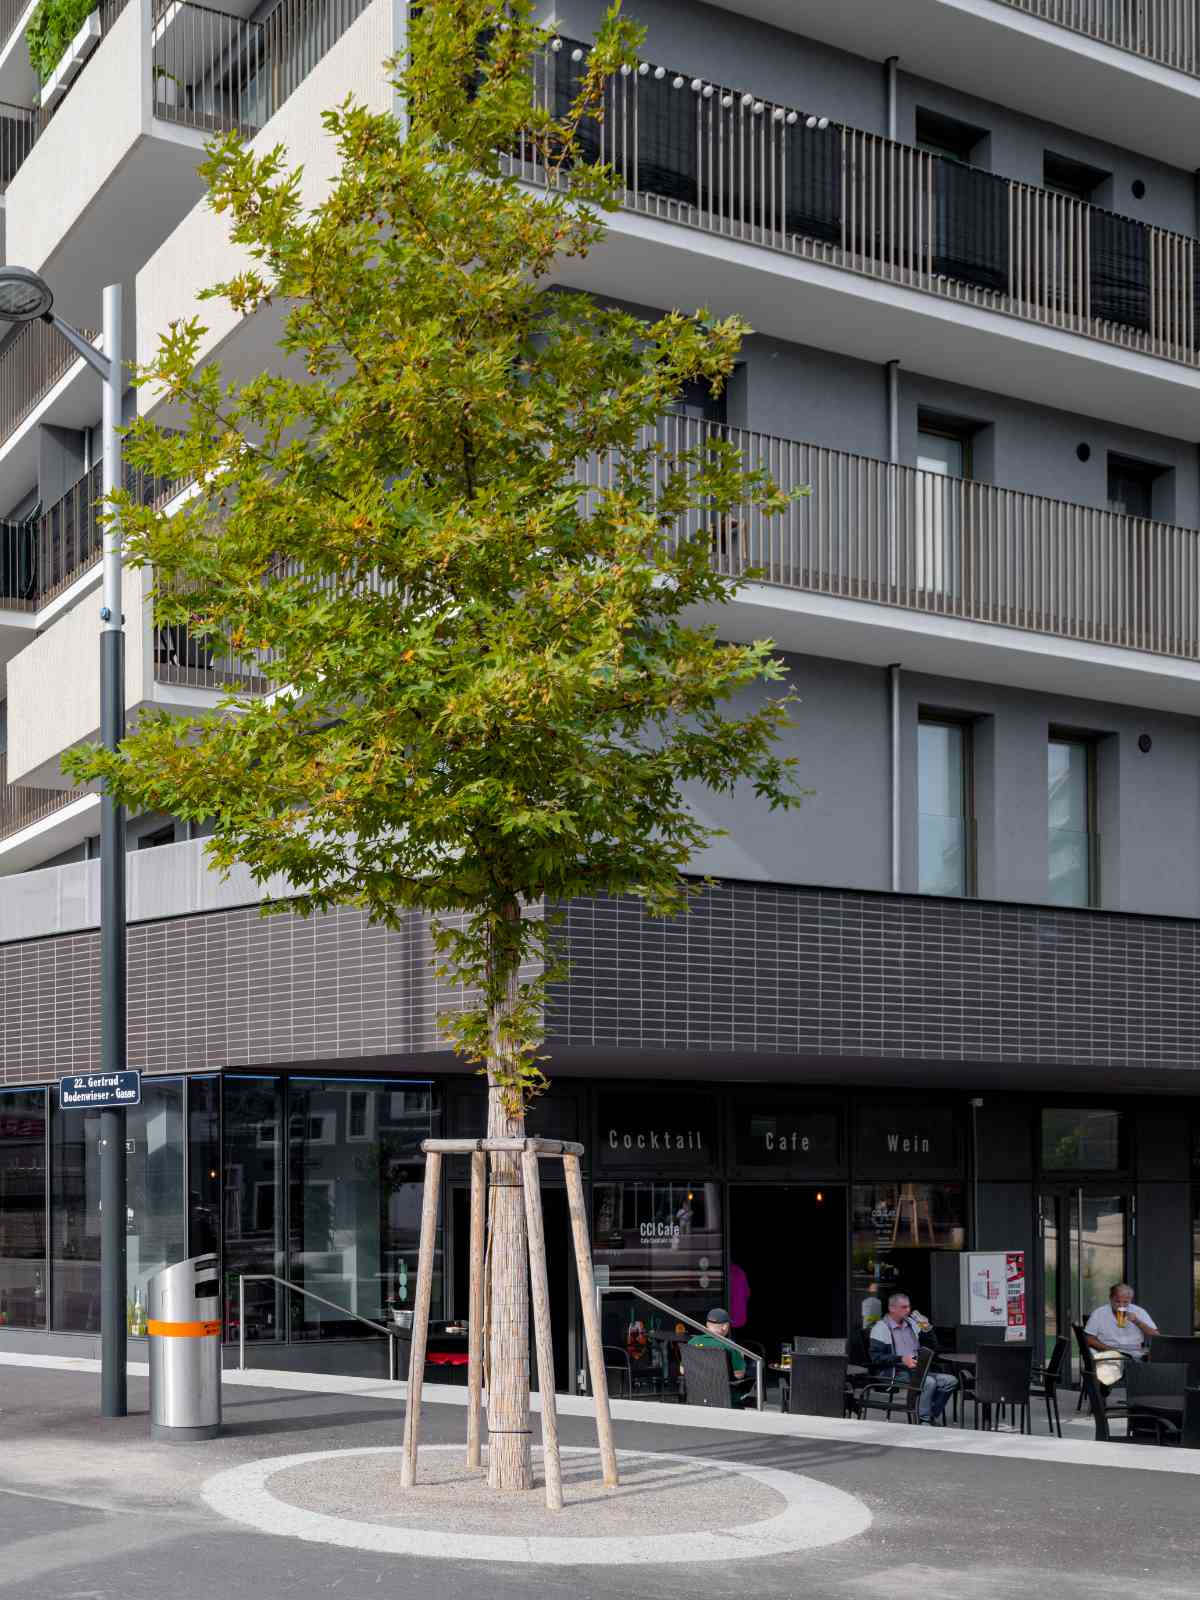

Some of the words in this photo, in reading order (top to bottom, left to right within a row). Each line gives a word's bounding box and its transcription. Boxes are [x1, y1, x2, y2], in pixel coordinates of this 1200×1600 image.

[88, 1075, 119, 1087] Gertrud
[609, 1129, 702, 1149] Cocktail
[766, 1132, 809, 1150] Cafe
[888, 1134, 929, 1152] Wein
[640, 1222, 656, 1236] CCI
[657, 1222, 680, 1236] Cafe
